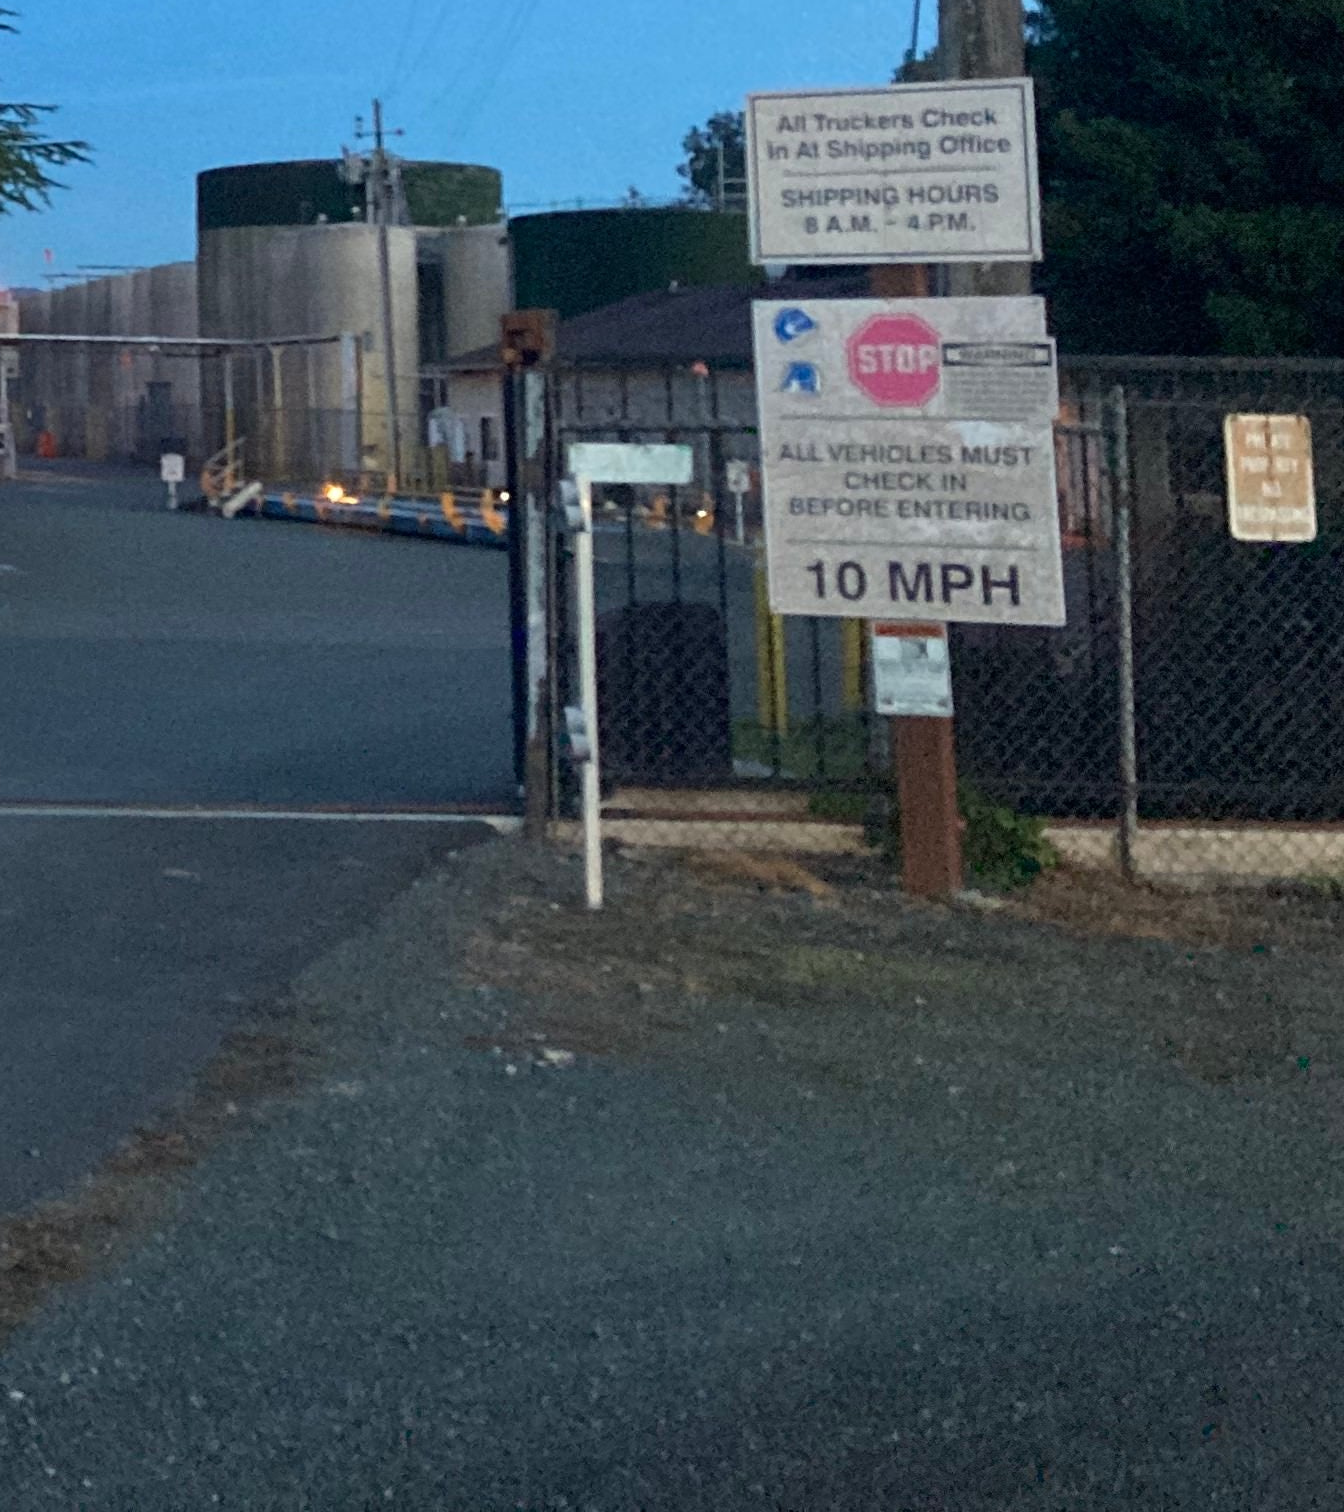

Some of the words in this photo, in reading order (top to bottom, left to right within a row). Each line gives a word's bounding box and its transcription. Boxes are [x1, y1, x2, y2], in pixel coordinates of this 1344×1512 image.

[777, 113, 806, 133] All
[814, 110, 914, 131] Truckers
[921, 107, 997, 128] Check
[767, 141, 788, 160] In
[796, 140, 819, 160] At
[827, 138, 931, 161] Shipping
[939, 134, 1011, 155] Office
[781, 186, 899, 208] SHIPPING
[909, 183, 1000, 205] HOURS
[858, 343, 940, 375] STOP
[780, 444, 820, 462] ALL
[827, 445, 953, 464] VEHICLES
[961, 445, 1032, 465] MUST
[844, 471, 936, 491] CHECK
[942, 473, 967, 492] IN
[790, 496, 889, 518] BEFORE
[897, 500, 1031, 521] ENTERING
[806, 560, 867, 601] 10
[887, 561, 1021, 607] MPH
